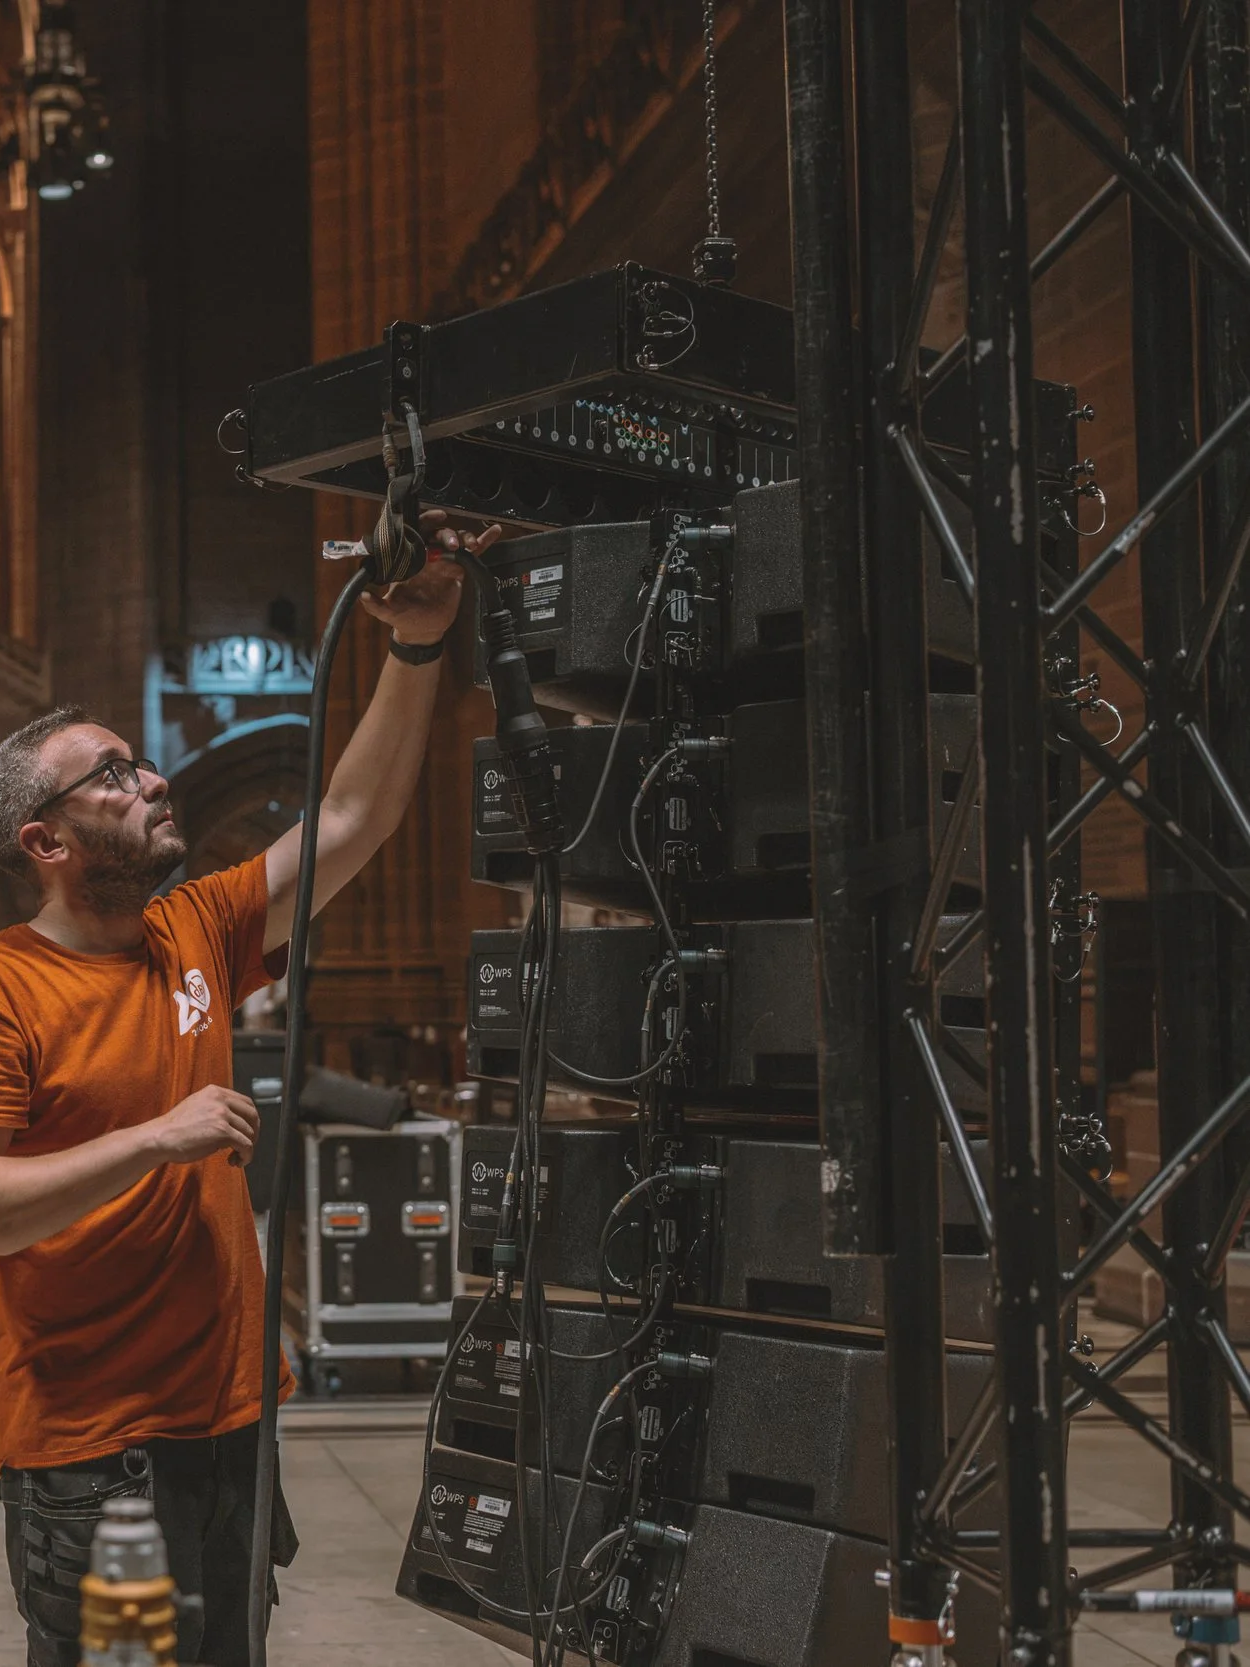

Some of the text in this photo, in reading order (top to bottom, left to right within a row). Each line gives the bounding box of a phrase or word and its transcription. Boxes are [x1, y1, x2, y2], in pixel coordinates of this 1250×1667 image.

[501, 576, 518, 588] WPS
[494, 968, 512, 978] WPS
[486, 1167, 504, 1178] WPS
[474, 1339, 493, 1351] WPS
[446, 1492, 465, 1505] WPS
